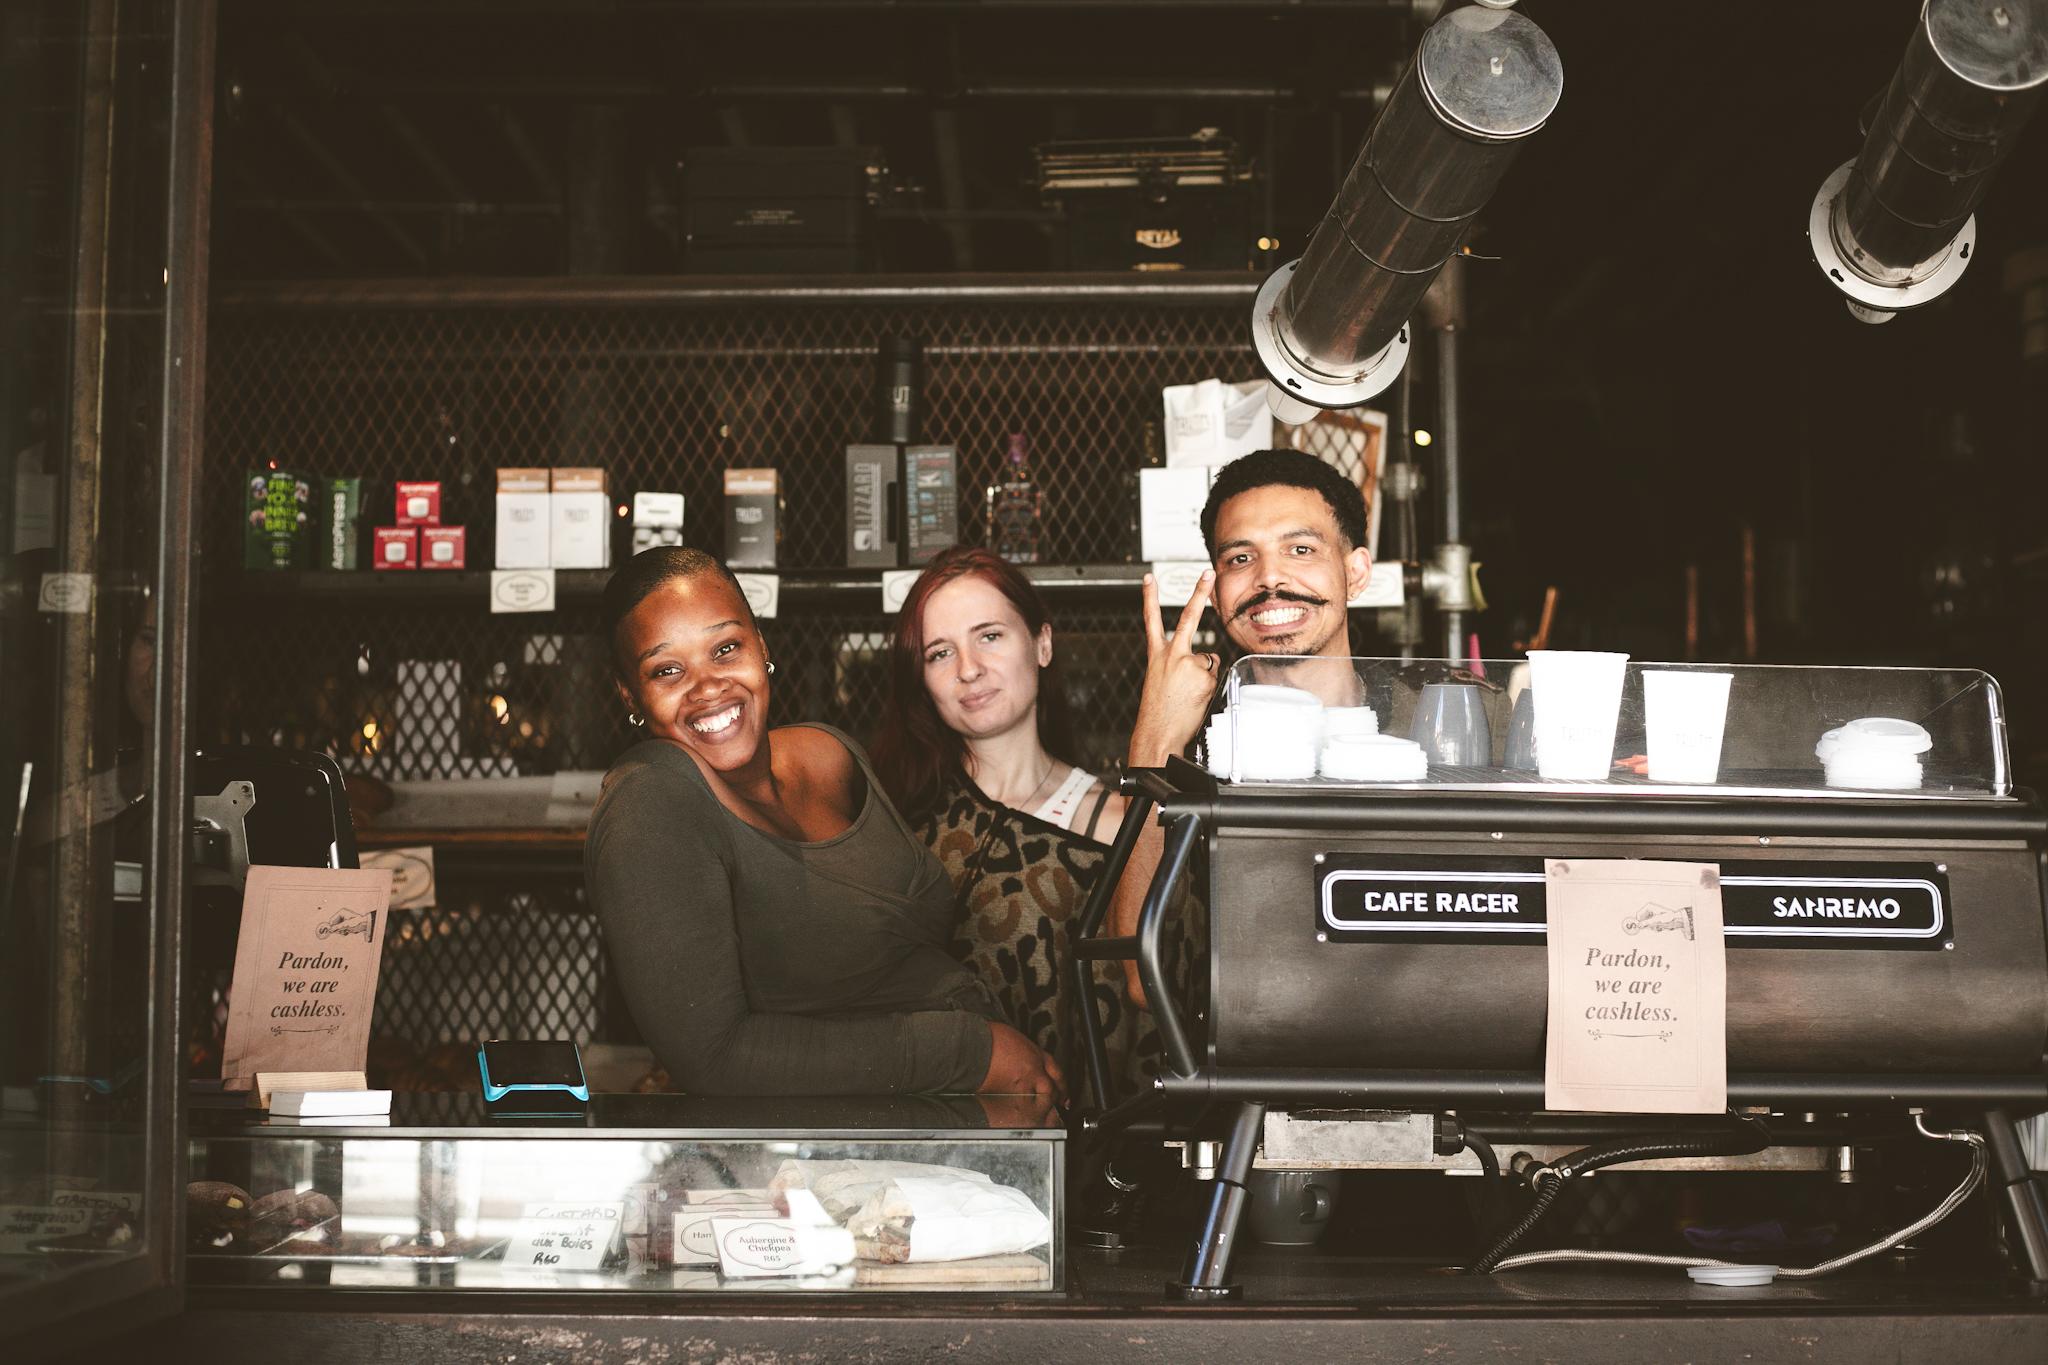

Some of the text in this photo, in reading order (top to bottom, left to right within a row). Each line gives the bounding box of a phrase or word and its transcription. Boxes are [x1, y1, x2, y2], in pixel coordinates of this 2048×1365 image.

[854, 463, 872, 531] LIZZARD
[1364, 892, 1519, 913] CAFE RACER
[1773, 896, 1900, 920] SANREMO
[279, 951, 349, 973] Pardon,
[1585, 947, 1670, 972] Pardon,
[283, 980, 339, 993] we are
[1595, 979, 1662, 994] we are
[270, 1000, 346, 1018] cashless.
[1585, 1001, 1678, 1021] cashless.
[739, 1236, 796, 1246] Aubergine &
[748, 1244, 791, 1253] Chickpea
